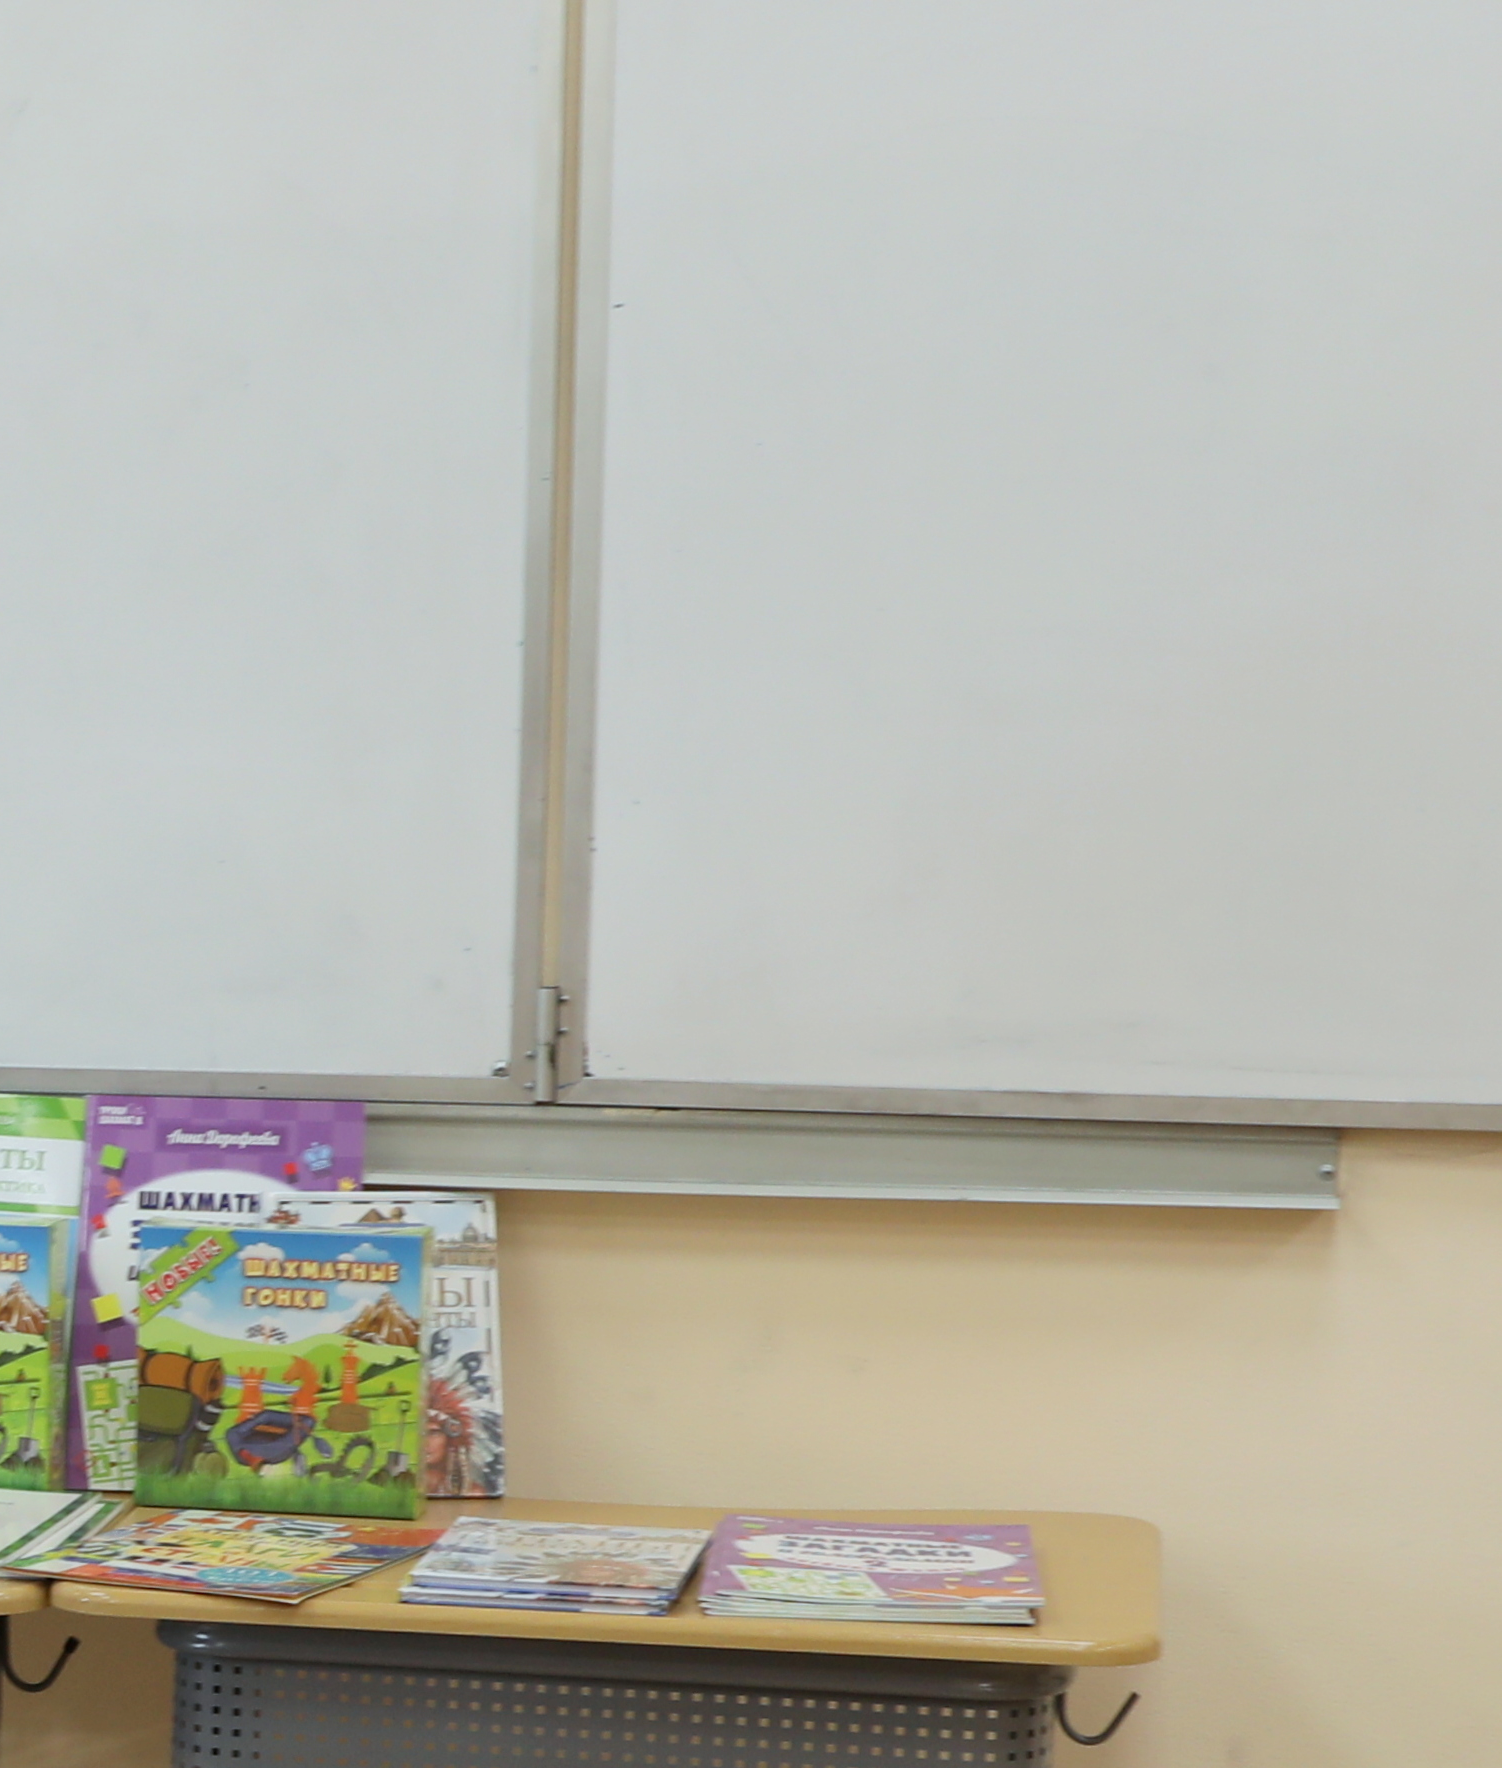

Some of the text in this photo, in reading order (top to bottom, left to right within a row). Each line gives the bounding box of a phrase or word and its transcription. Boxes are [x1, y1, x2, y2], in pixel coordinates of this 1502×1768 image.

[166, 1129, 280, 1149] Анна Дорофеева
[243, 1257, 401, 1283] ШАХМАТНЫЕ
[243, 1286, 328, 1309] ГОНКИ
[777, 1539, 974, 1557] ЗАГАДКИ
